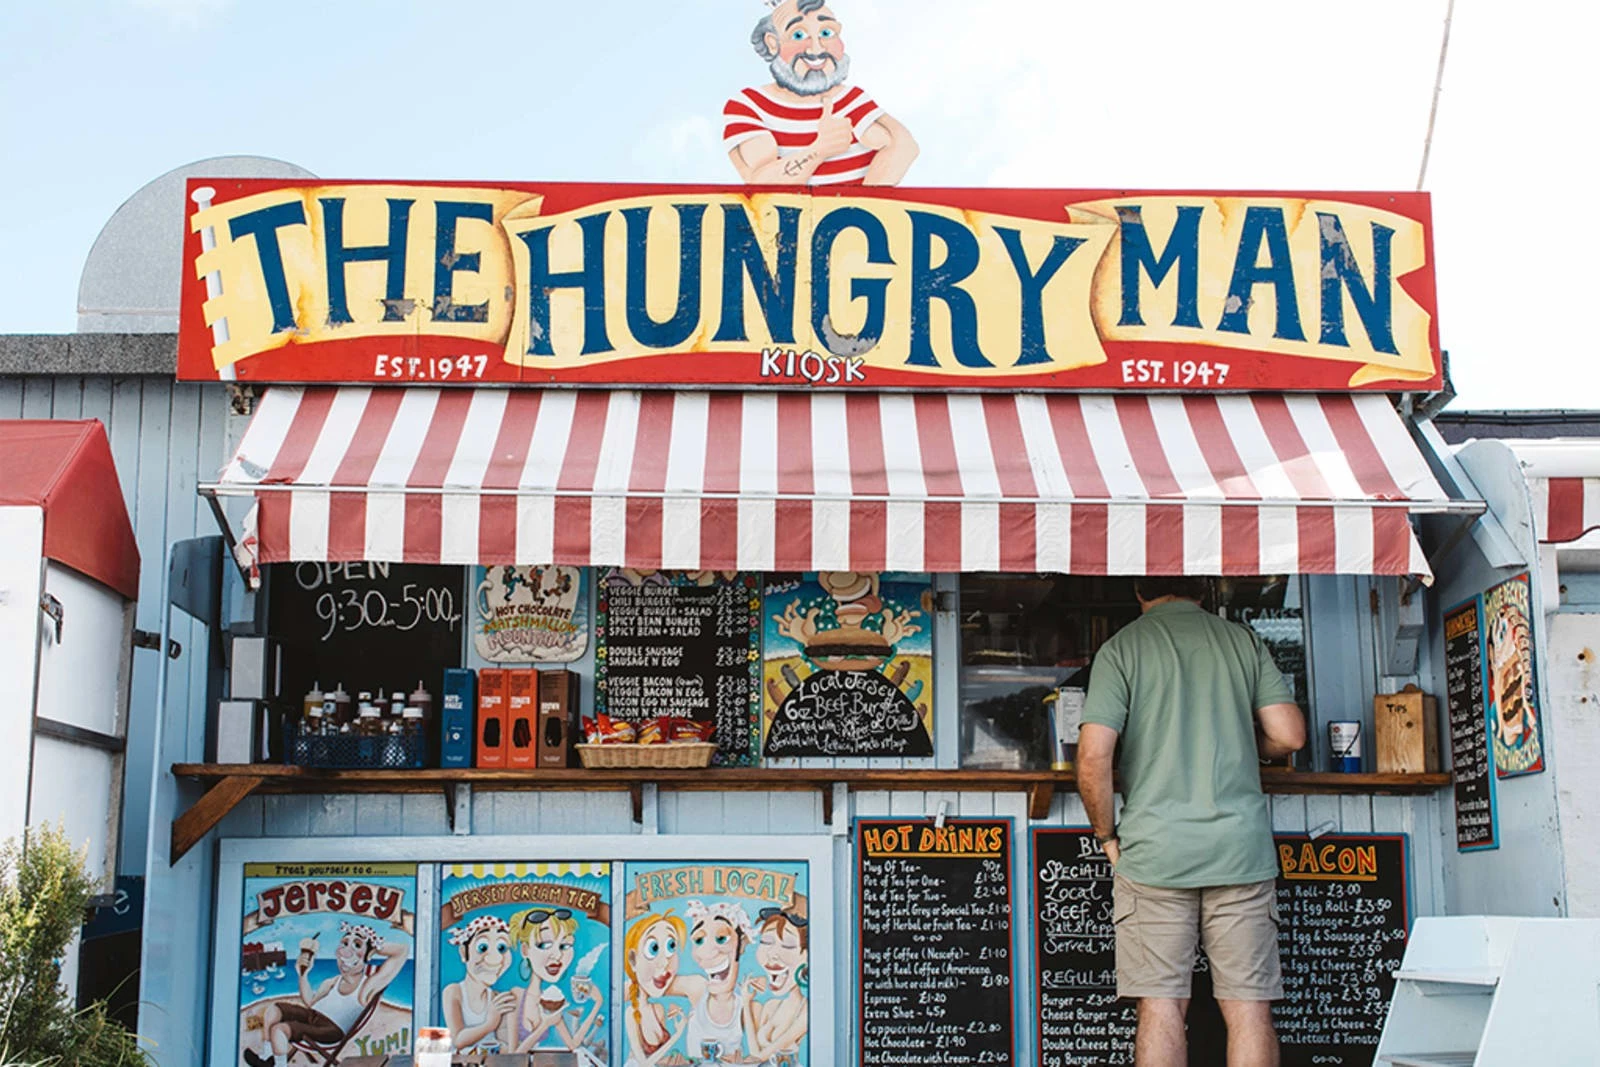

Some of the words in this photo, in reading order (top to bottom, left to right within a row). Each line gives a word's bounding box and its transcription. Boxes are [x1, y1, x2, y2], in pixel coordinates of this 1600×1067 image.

[228, 198, 495, 334] THE
[517, 203, 1088, 368] HUNGRY
[1114, 204, 1402, 356] MAN
[760, 347, 865, 382] KIOSK
[1172, 361, 1230, 384] 1947
[296, 561, 389, 589] OPEN
[609, 587, 641, 595] VEGGIE
[644, 587, 679, 596] BURGER
[636, 597, 671, 606] BURGER
[496, 605, 515, 617] HOT
[518, 604, 572, 619] CHOCOLATE
[609, 607, 640, 616] VEGGIE
[643, 607, 677, 616] BURGER
[684, 607, 712, 616] SALAD
[609, 617, 634, 626] SPICY
[637, 617, 662, 626] BEAN
[666, 617, 701, 626] BURGER
[609, 627, 634, 636] SPICY
[637, 627, 662, 636] BEAN
[670, 627, 701, 636] SALAD
[609, 647, 642, 656] DOUBLE
[645, 647, 684, 656] SAUSAGE
[609, 657, 647, 666] SAUSAGE
[662, 657, 680, 666] EGG
[608, 677, 639, 686] VEGGIE
[643, 677, 673, 686] BACON
[608, 687, 641, 696] VEGGIE
[643, 687, 673, 696] BACON
[685, 687, 704, 697] EGG
[608, 698, 638, 706] BACON
[641, 698, 658, 706] EGG
[670, 698, 709, 707] SAUSAGE
[652, 708, 693, 717] SAUSAGE
[864, 826, 913, 851] HOT
[1279, 842, 1377, 875] BACON
[276, 865, 305, 874] Treat
[309, 865, 349, 876] yourself
[863, 860, 882, 875] Mug
[639, 870, 703, 903] FRESH
[714, 869, 790, 903] LOCAL
[863, 875, 877, 886] Pot
[880, 876, 888, 887] of
[891, 875, 904, 886] Tea
[906, 875, 919, 888] for
[921, 875, 939, 886] One
[261, 881, 400, 919] Jersey
[453, 886, 509, 914] JERSEY
[511, 886, 561, 902] CREAM
[567, 891, 596, 910] TEA
[863, 890, 877, 901] Pot
[880, 890, 887, 902] of
[890, 890, 904, 901] Tea
[907, 890, 920, 904] for
[863, 904, 880, 918] Mug
[882, 904, 890, 918] of
[892, 904, 910, 916] Earl
[911, 904, 930, 918] Grey
[941, 904, 969, 916] Special
[1303, 901, 1322, 916] Egg
[863, 919, 880, 934] Mug
[882, 919, 890, 933] of
[893, 919, 921, 930] Herbal
[1044, 937, 1098, 954] Served
[1293, 932, 1311, 945] Egg
[1324, 932, 1365, 945] Sausage
[864, 948, 881, 963] Mug
[883, 948, 891, 963] of
[893, 947, 919, 962] Coffee
[864, 963, 880, 978] Mug
[883, 963, 891, 977] of
[894, 963, 912, 975] Real
[914, 963, 940, 977] Coffee
[1291, 959, 1309, 973] Egg
[875, 979, 893, 989] with
[895, 979, 908, 989] hot
[919, 978, 935, 989] cold
[1042, 993, 1074, 1009] Burger
[864, 1007, 889, 1018] Extra
[892, 1006, 915, 1018] Shot
[1041, 1008, 1074, 1020] Cheese
[1076, 1008, 1108, 1023] Burger
[1317, 1004, 1354, 1015] Cheese
[1331, 1016, 1365, 1030] Cheese
[1042, 1023, 1071, 1035] Bacon
[1073, 1023, 1106, 1035] Cheese
[1108, 1023, 1136, 1038] Burge
[356, 1028, 409, 1057] YUM!
[864, 1037, 879, 1047] Hot
[881, 1035, 925, 1048] Chocolate
[1042, 1038, 1074, 1050] Double
[1075, 1038, 1108, 1050] Cheese
[1343, 1032, 1378, 1045] Tomato
[864, 1051, 879, 1063] Hot
[881, 1051, 921, 1064] Chocolate
[923, 1051, 942, 1063] with
[944, 1051, 970, 1063] Cream
[1043, 1053, 1060, 1067] Egg
[1065, 1052, 1098, 1067] Burger
